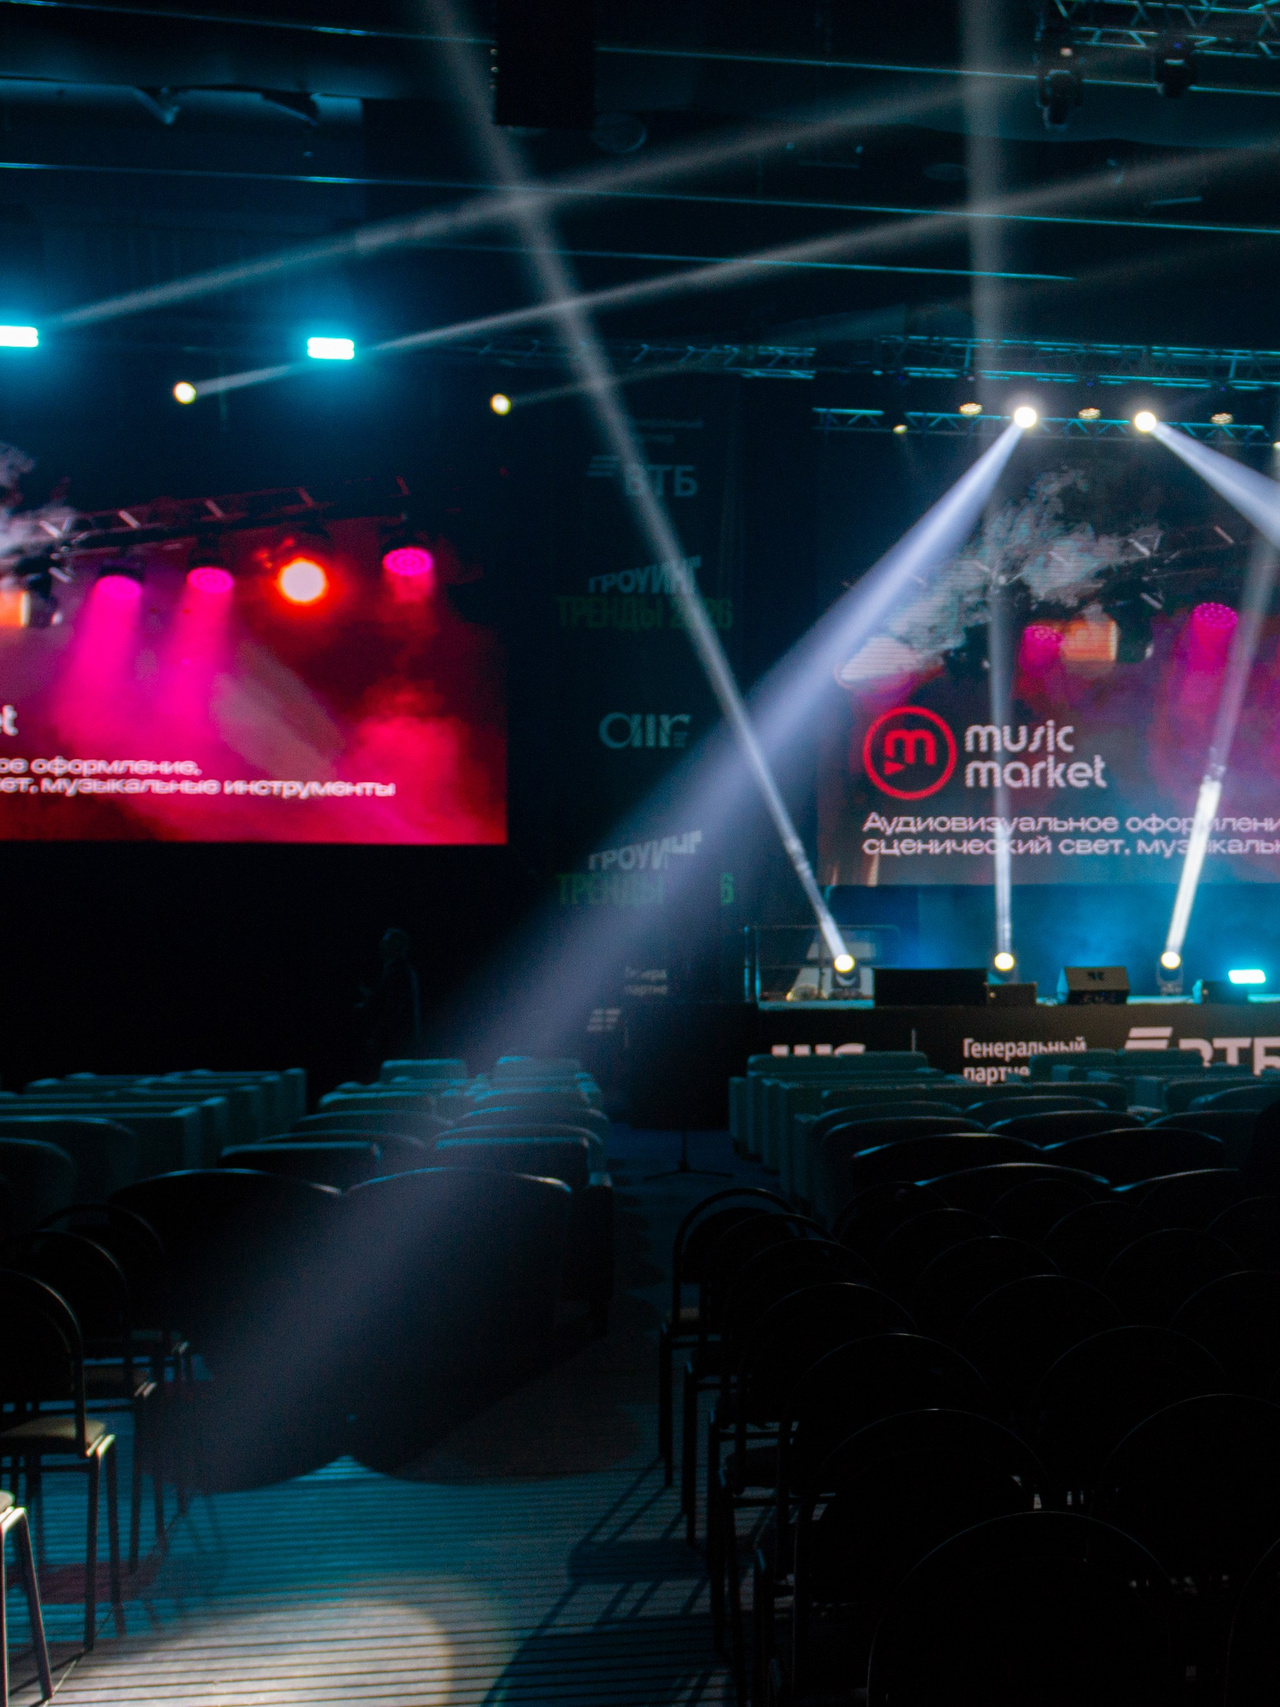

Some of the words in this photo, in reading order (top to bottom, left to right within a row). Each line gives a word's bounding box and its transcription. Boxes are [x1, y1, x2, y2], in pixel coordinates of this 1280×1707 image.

[964, 720, 1075, 753] music
[30, 755, 203, 776] оформление,
[964, 754, 1107, 789] market
[41, 777, 220, 797] музыкальные
[223, 780, 396, 800] инструменты
[861, 811, 1119, 836] Аудиовизуальное
[862, 835, 1052, 857] сценический
[1057, 838, 1132, 857] свет,
[963, 1036, 1088, 1062] Генеральный
